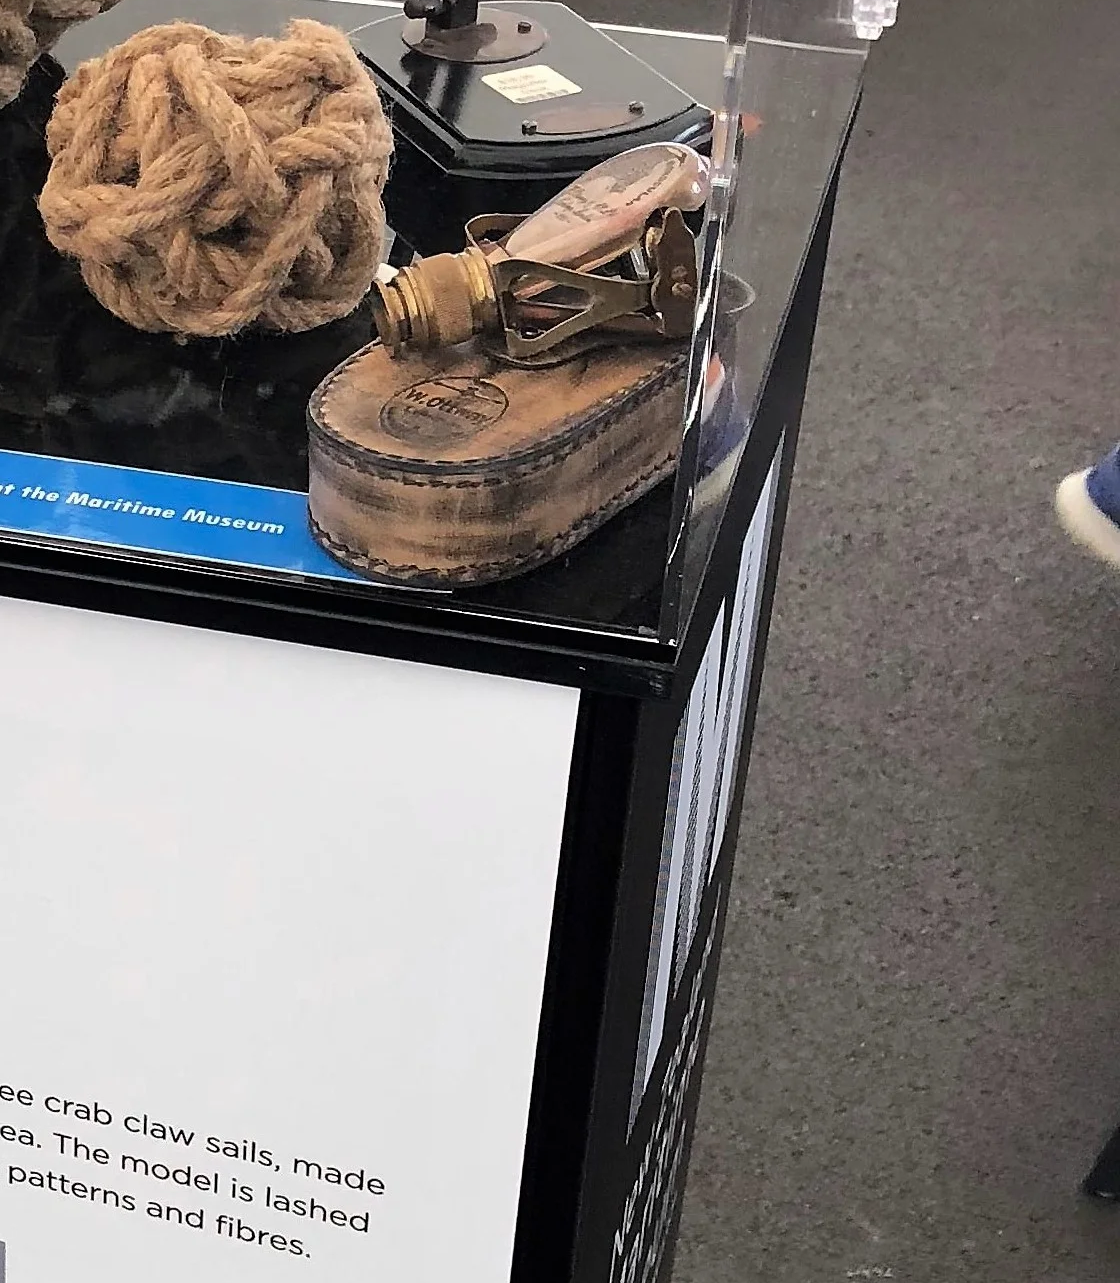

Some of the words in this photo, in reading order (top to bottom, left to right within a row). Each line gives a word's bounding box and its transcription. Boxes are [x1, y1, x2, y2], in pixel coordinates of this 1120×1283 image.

[21, 486, 60, 503] the
[65, 491, 177, 520] Maritime
[182, 508, 286, 536] Museum
[44, 1094, 113, 1126] crab
[123, 1114, 195, 1147] claw
[206, 1133, 281, 1173] sails,
[293, 1154, 386, 1196] made
[53, 1131, 110, 1166] The
[120, 1151, 220, 1195] model
[231, 1177, 255, 1203] is
[266, 1186, 370, 1234] lashed
[7, 1163, 137, 1212] patterns
[145, 1200, 204, 1230] and
[215, 1214, 312, 1260] fibres.
